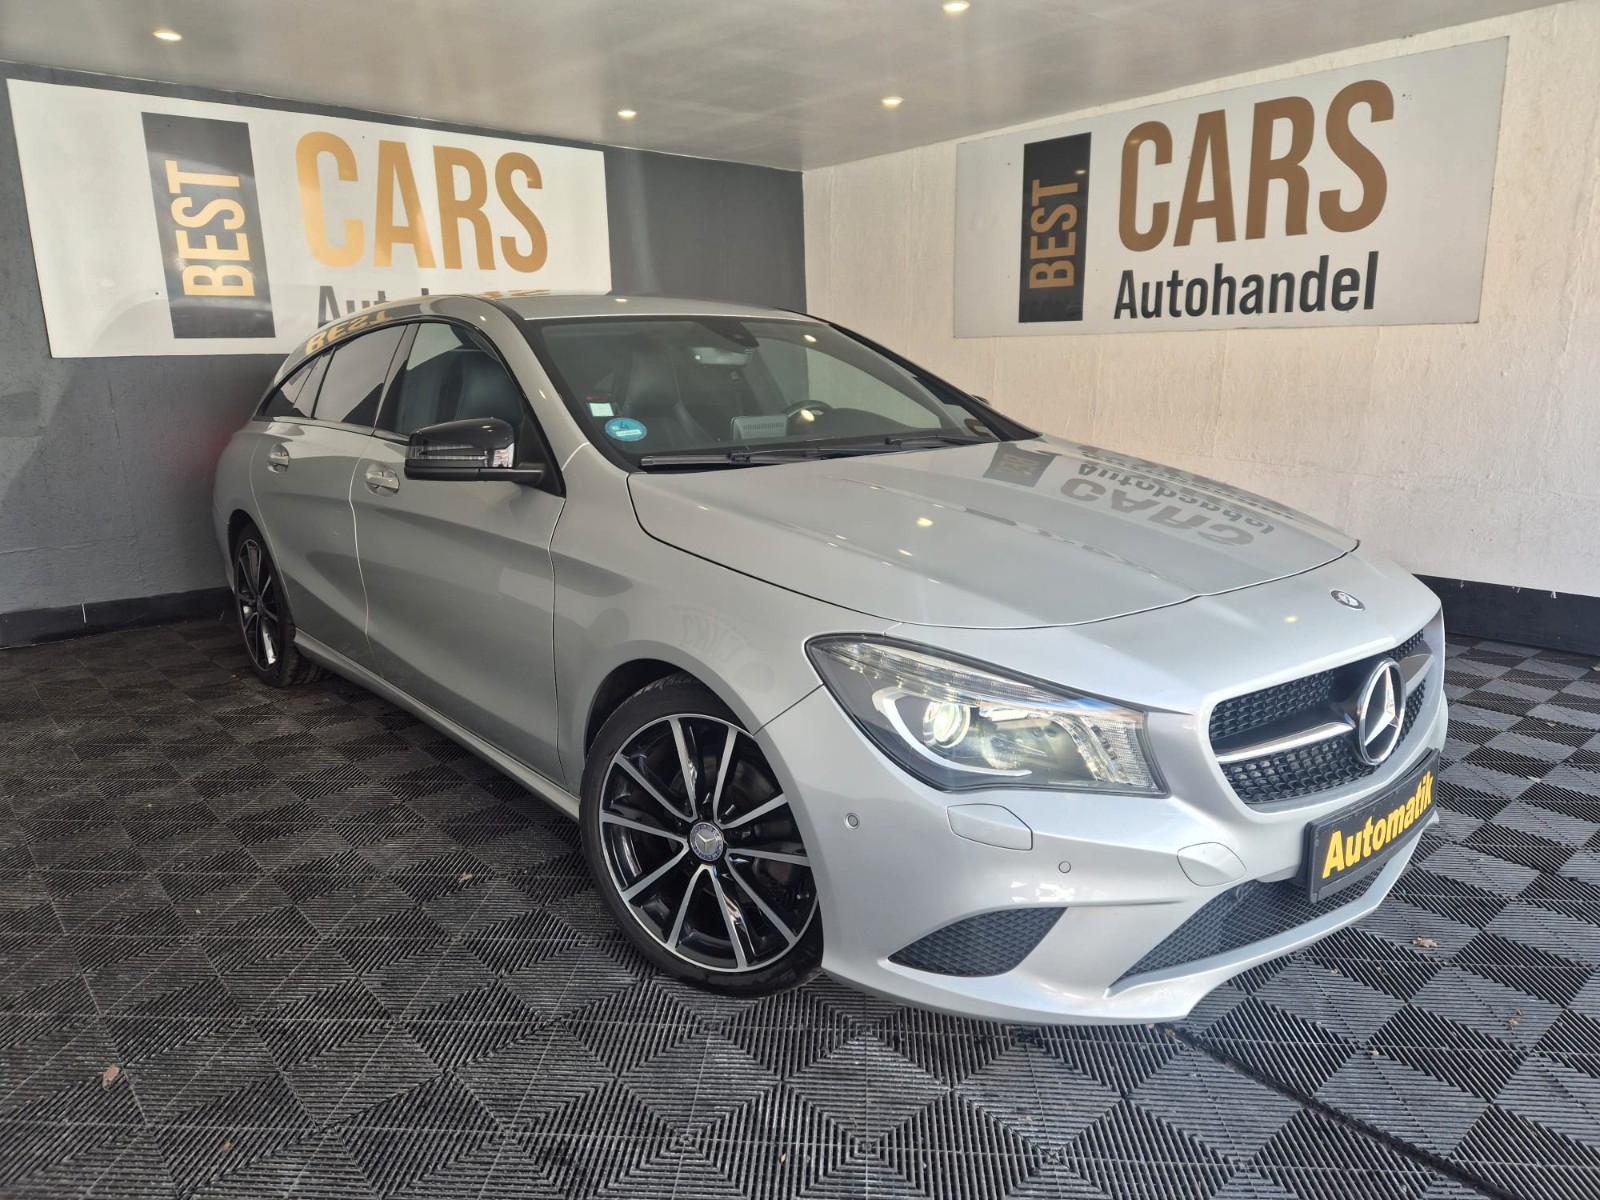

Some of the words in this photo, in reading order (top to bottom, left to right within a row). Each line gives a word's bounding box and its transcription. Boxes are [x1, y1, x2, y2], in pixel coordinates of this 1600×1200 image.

[295, 131, 548, 273] CARS
[1118, 80, 1394, 252] CARS
[165, 160, 255, 296] BEST
[1029, 180, 1079, 289] BEST
[1114, 251, 1379, 319] Autohandel
[1321, 770, 1435, 880] Automatik
